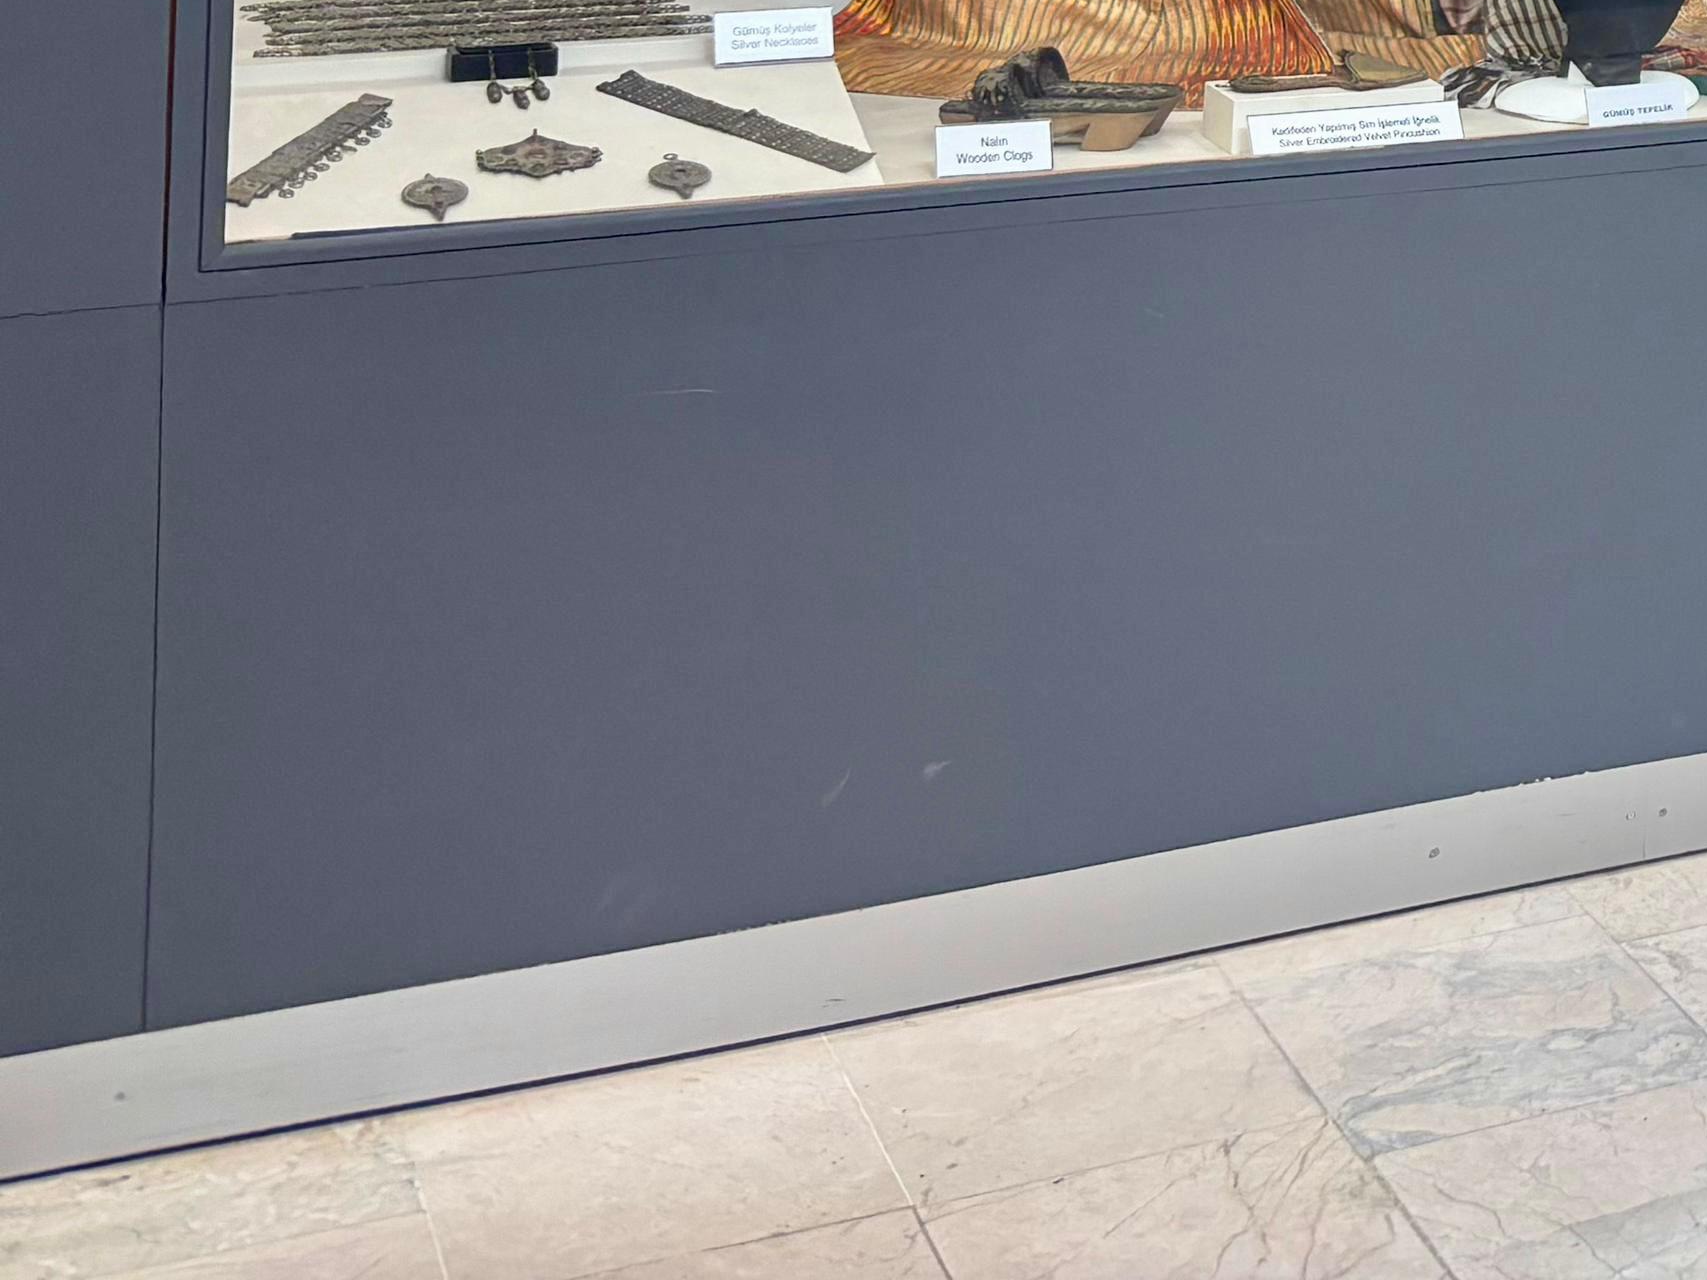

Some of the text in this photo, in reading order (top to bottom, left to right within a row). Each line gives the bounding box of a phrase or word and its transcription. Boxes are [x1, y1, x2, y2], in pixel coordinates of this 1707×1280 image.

[731, 39, 761, 50] Silver
[956, 150, 1034, 164] Wooden Clogs
